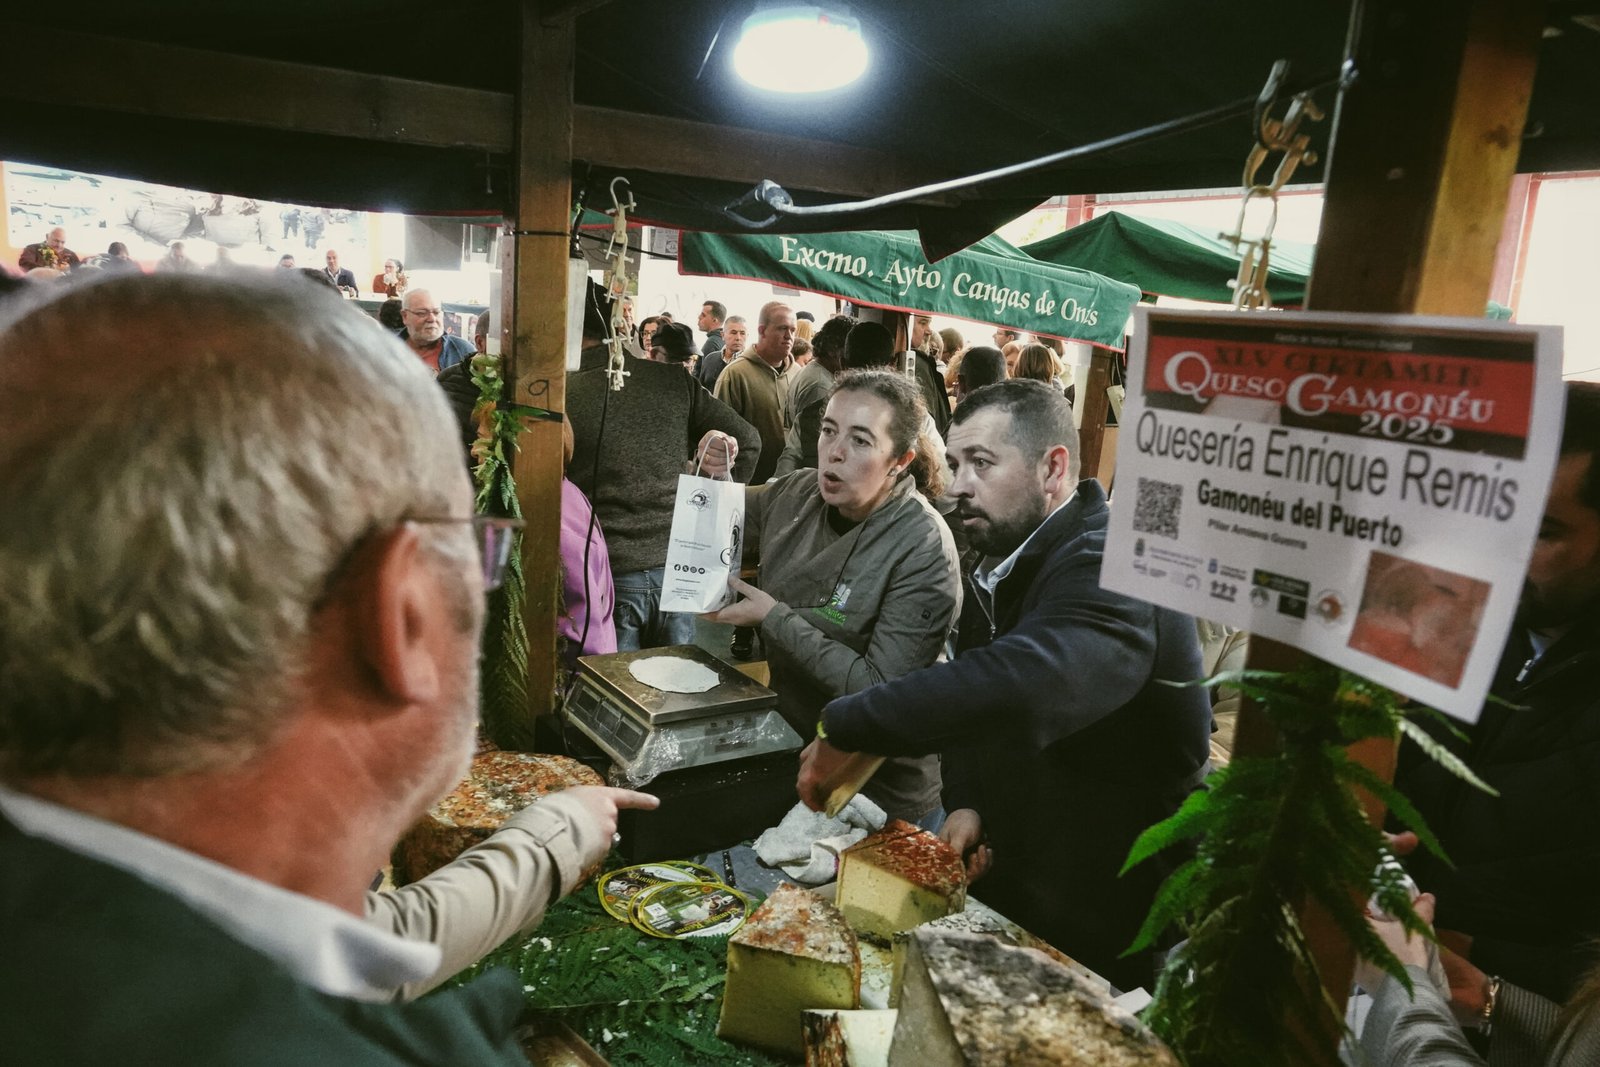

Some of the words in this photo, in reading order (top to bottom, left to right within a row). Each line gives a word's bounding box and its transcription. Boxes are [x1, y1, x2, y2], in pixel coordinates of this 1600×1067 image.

[778, 236, 874, 278] Excmo.
[953, 272, 1031, 315] Cangas
[1035, 289, 1056, 316] de
[1061, 298, 1099, 326] Onís
[1136, 410, 1254, 472] Quesería
[1264, 429, 1388, 501] Enrique
[1401, 449, 1518, 521] Remis
[1358, 410, 1454, 444] 2025
[1198, 478, 1285, 522] Gamonéu
[1291, 497, 1323, 530] del
[1329, 504, 1402, 547] Puerto
